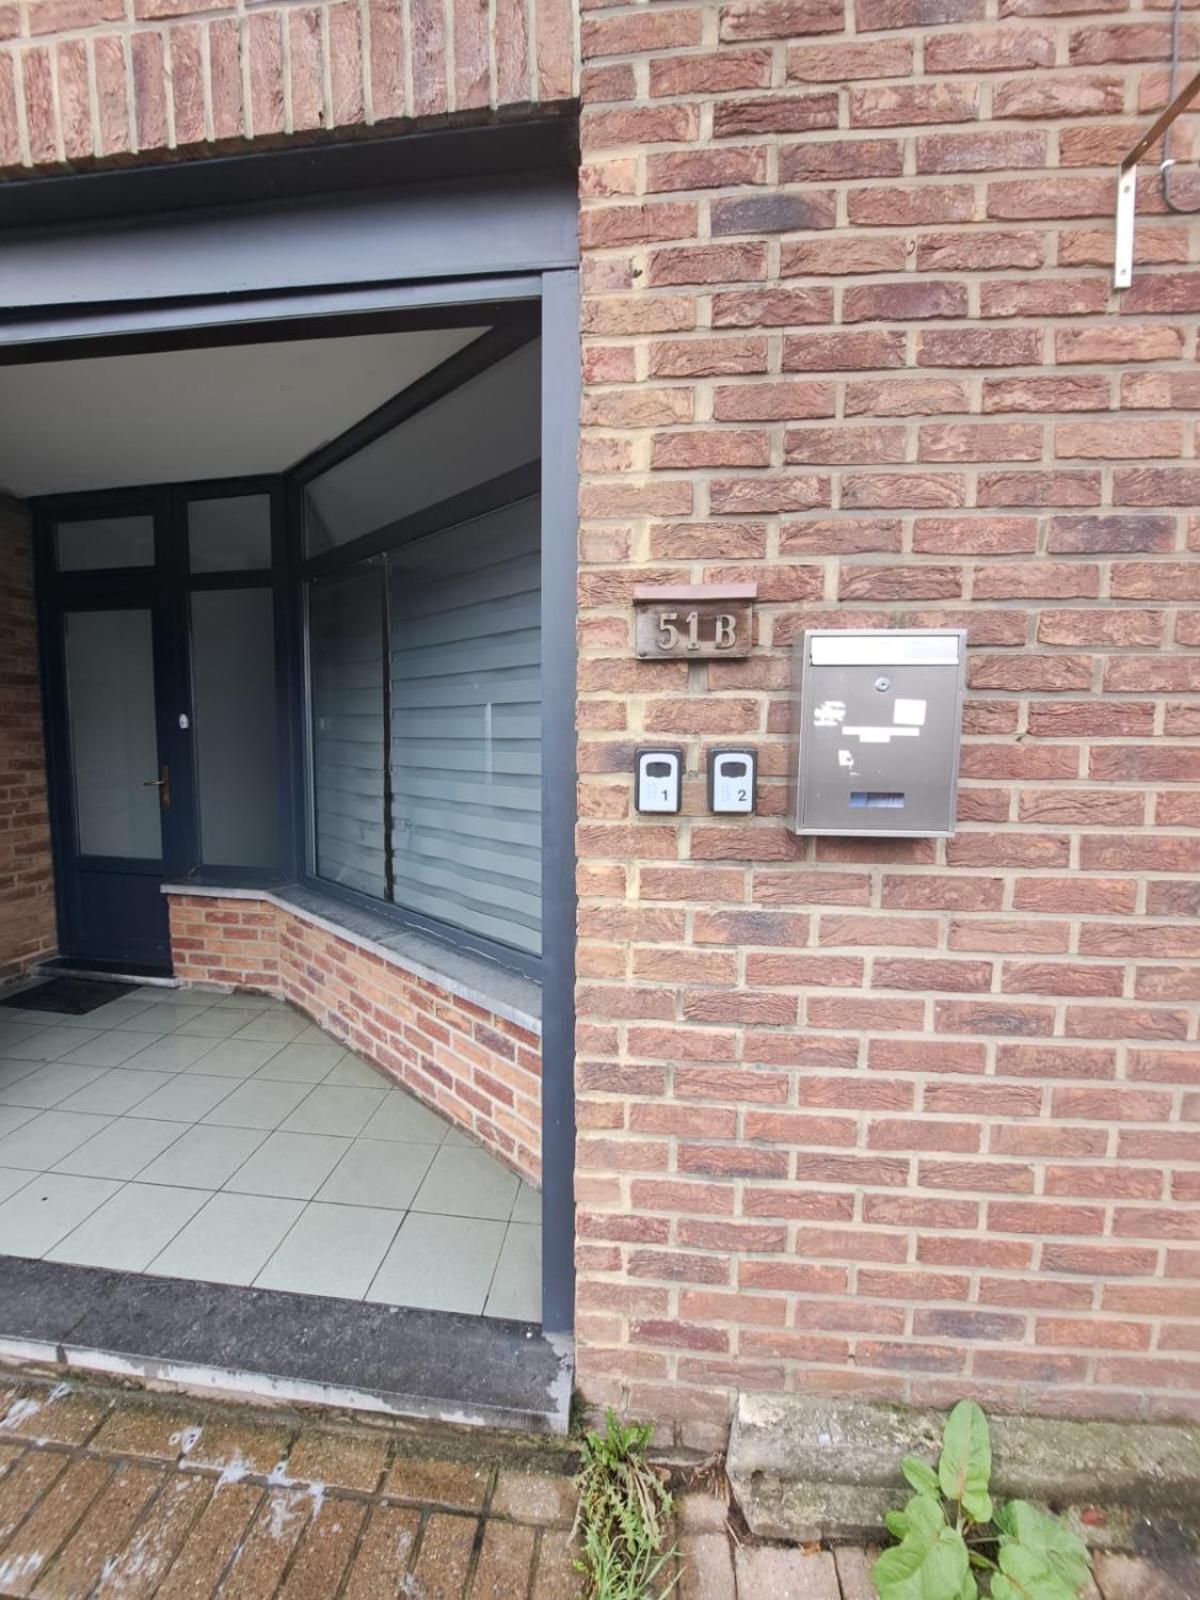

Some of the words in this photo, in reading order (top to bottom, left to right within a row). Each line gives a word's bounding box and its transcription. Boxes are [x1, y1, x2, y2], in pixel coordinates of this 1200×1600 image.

[657, 612, 700, 650] 51
[714, 614, 737, 649] B
[661, 789, 669, 802] 1
[737, 789, 748, 802] 2
